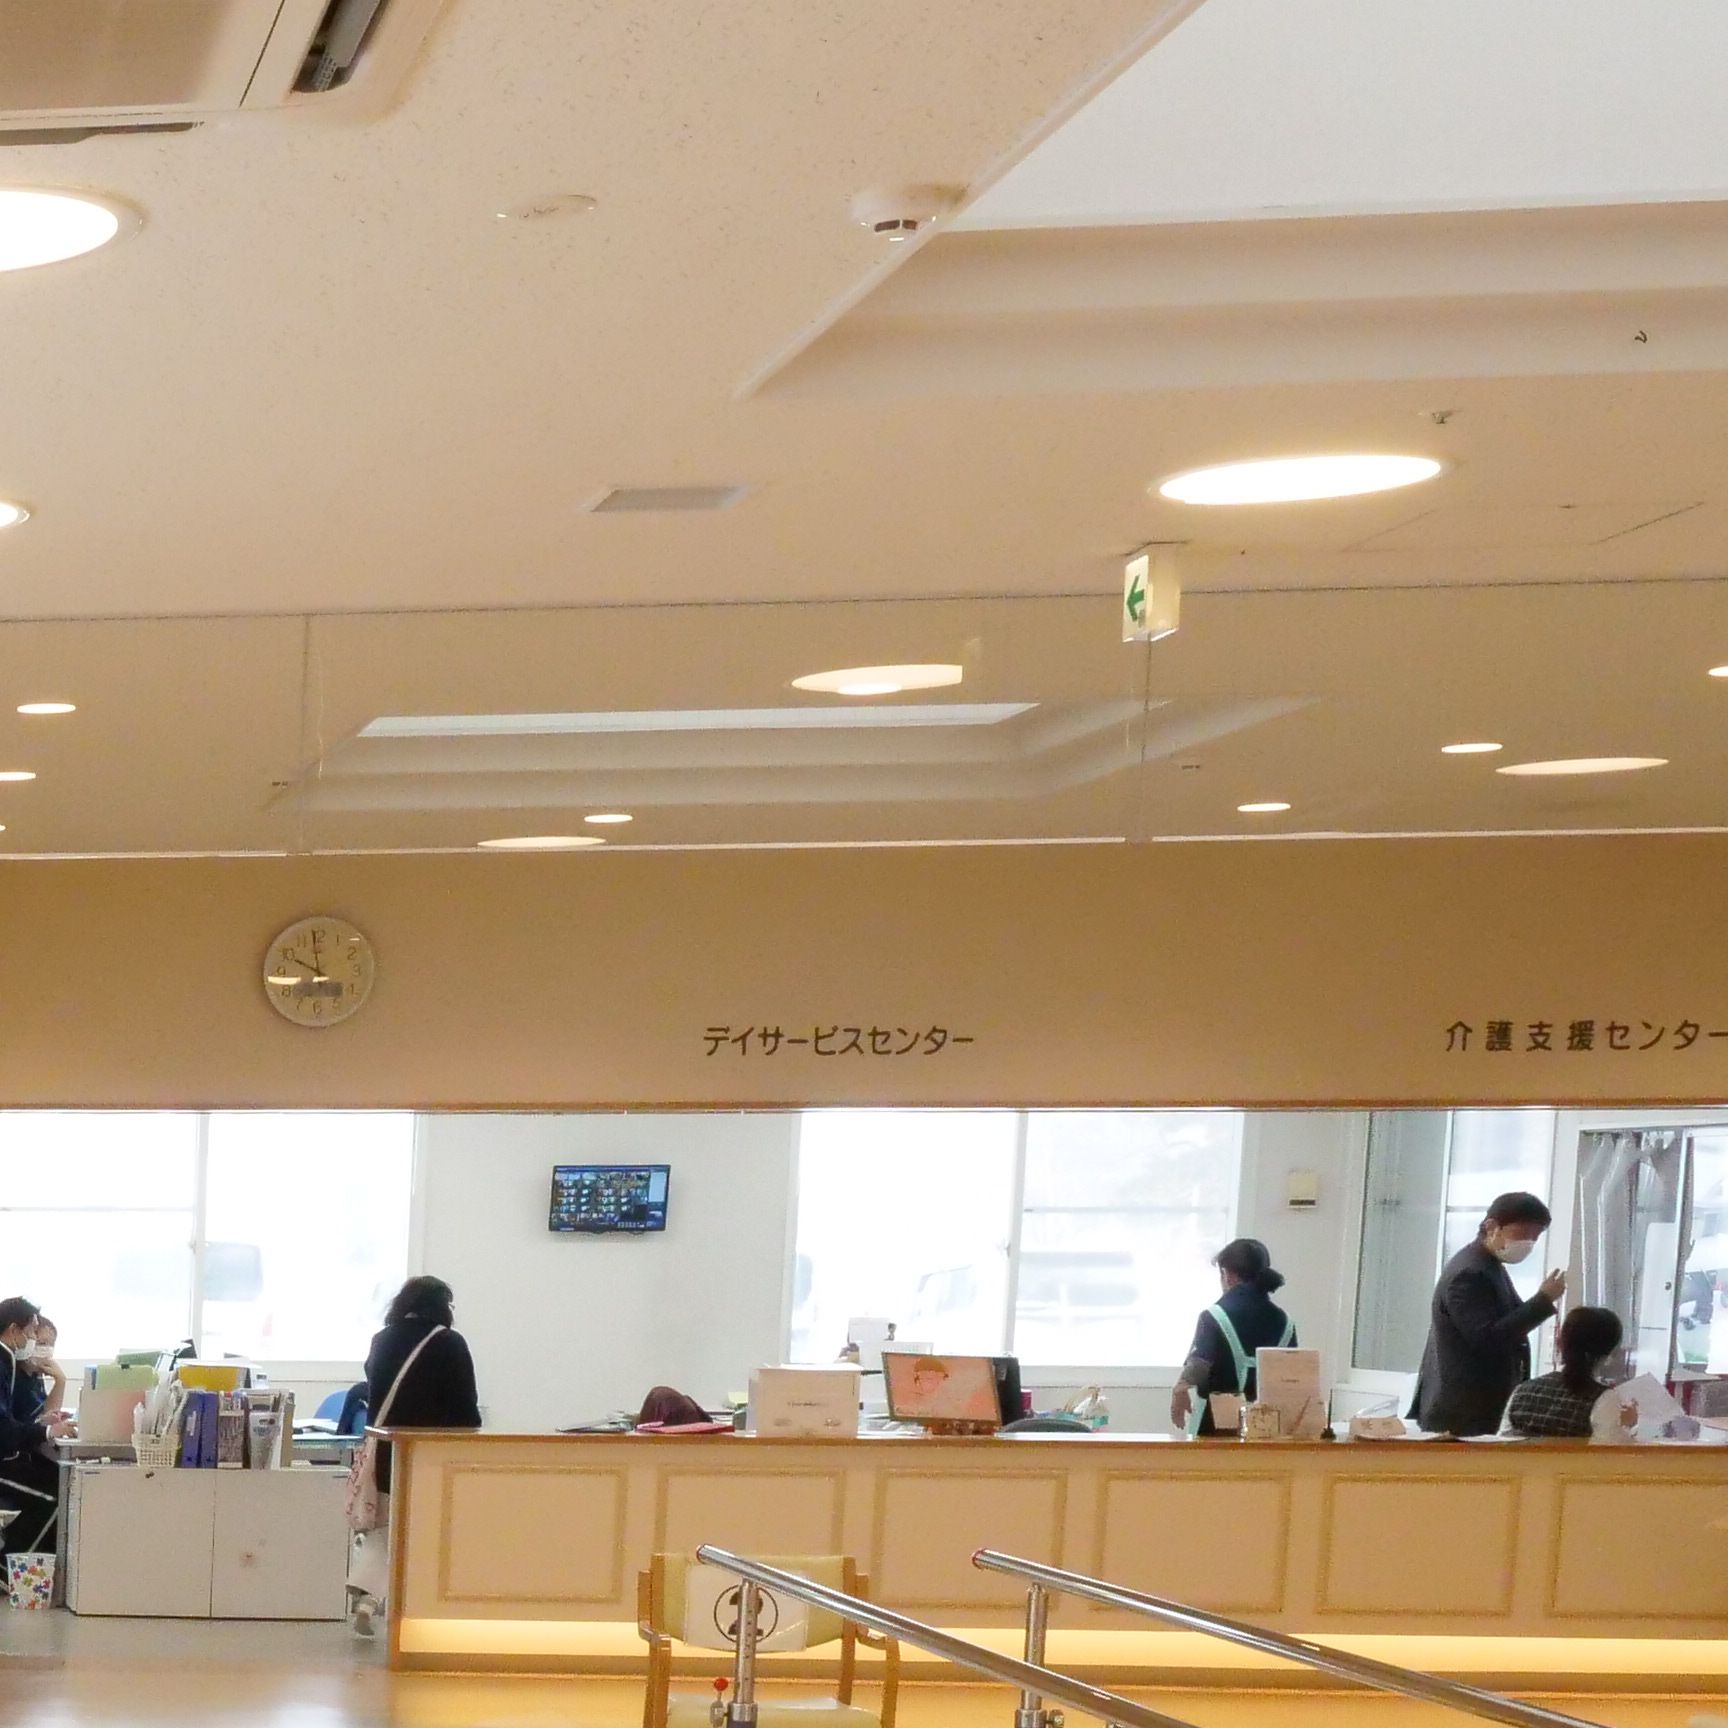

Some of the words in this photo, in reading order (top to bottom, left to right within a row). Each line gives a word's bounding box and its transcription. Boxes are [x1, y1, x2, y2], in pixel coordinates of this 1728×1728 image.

[703, 1025, 974, 1056] デイサービスセンター
[1445, 1019, 1728, 1052] 介護支援センター
